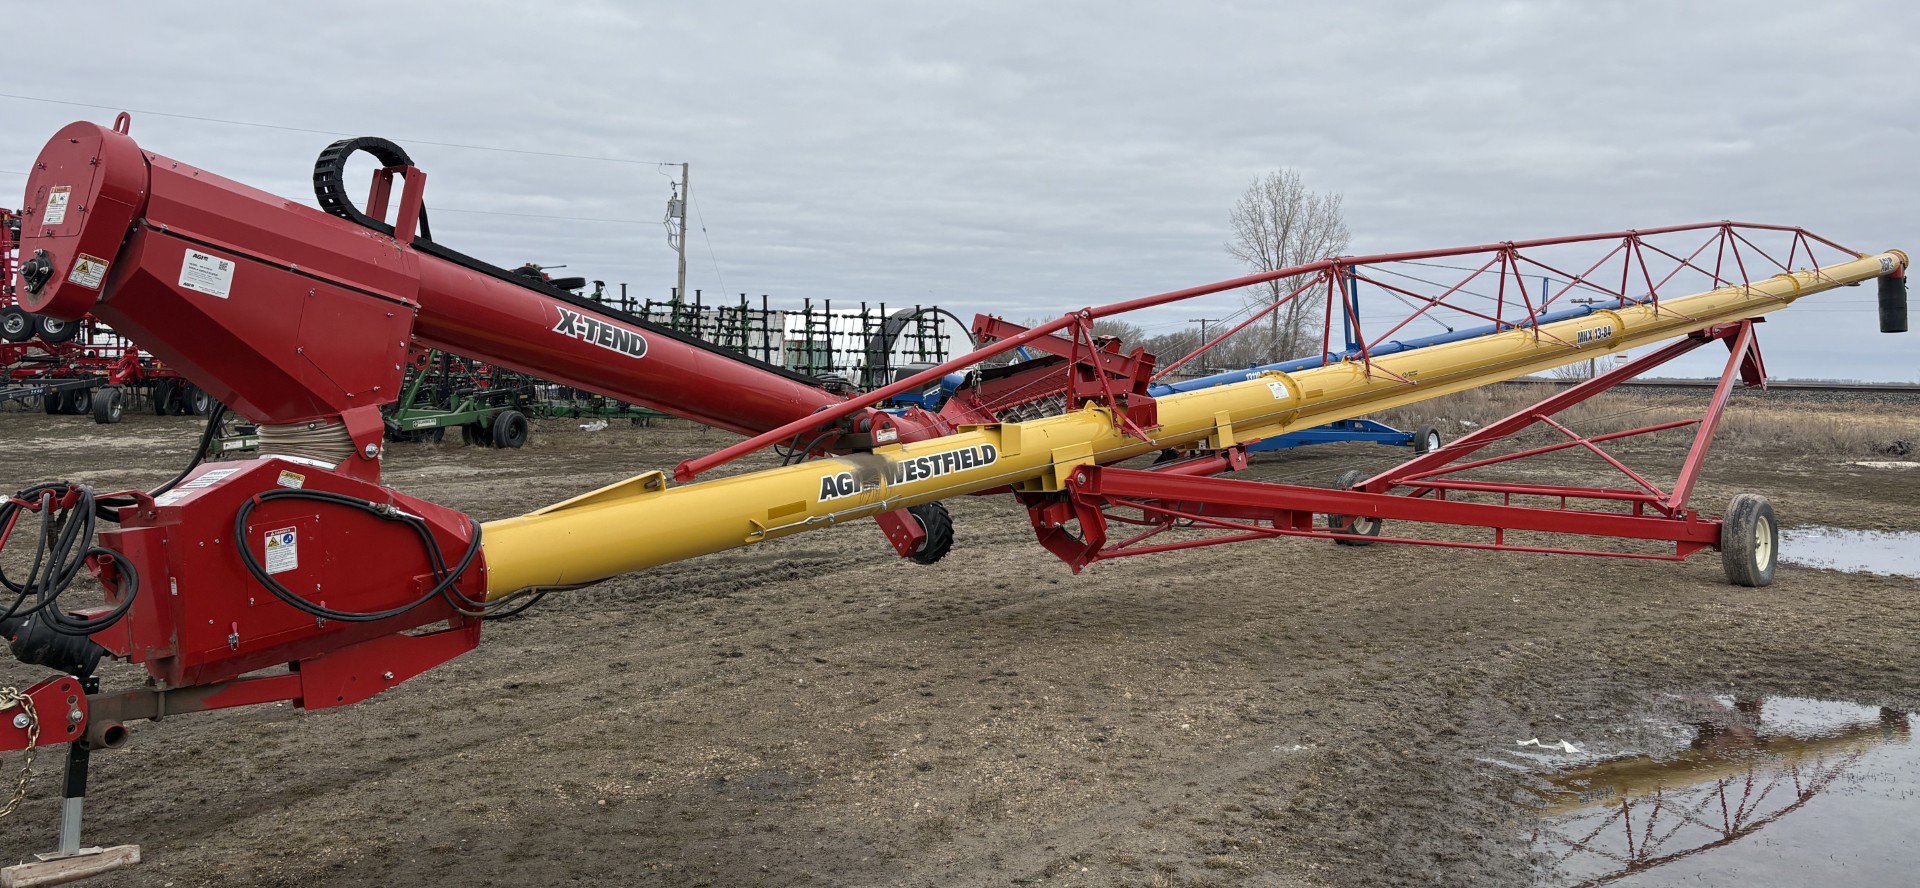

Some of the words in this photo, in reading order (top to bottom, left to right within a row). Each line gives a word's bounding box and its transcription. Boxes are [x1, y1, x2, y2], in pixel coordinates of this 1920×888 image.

[554, 306, 647, 357] X-TEND
[1577, 329, 1593, 343] MKX
[1594, 325, 1612, 339] 13-84
[885, 443, 998, 487] WESTFIELD
